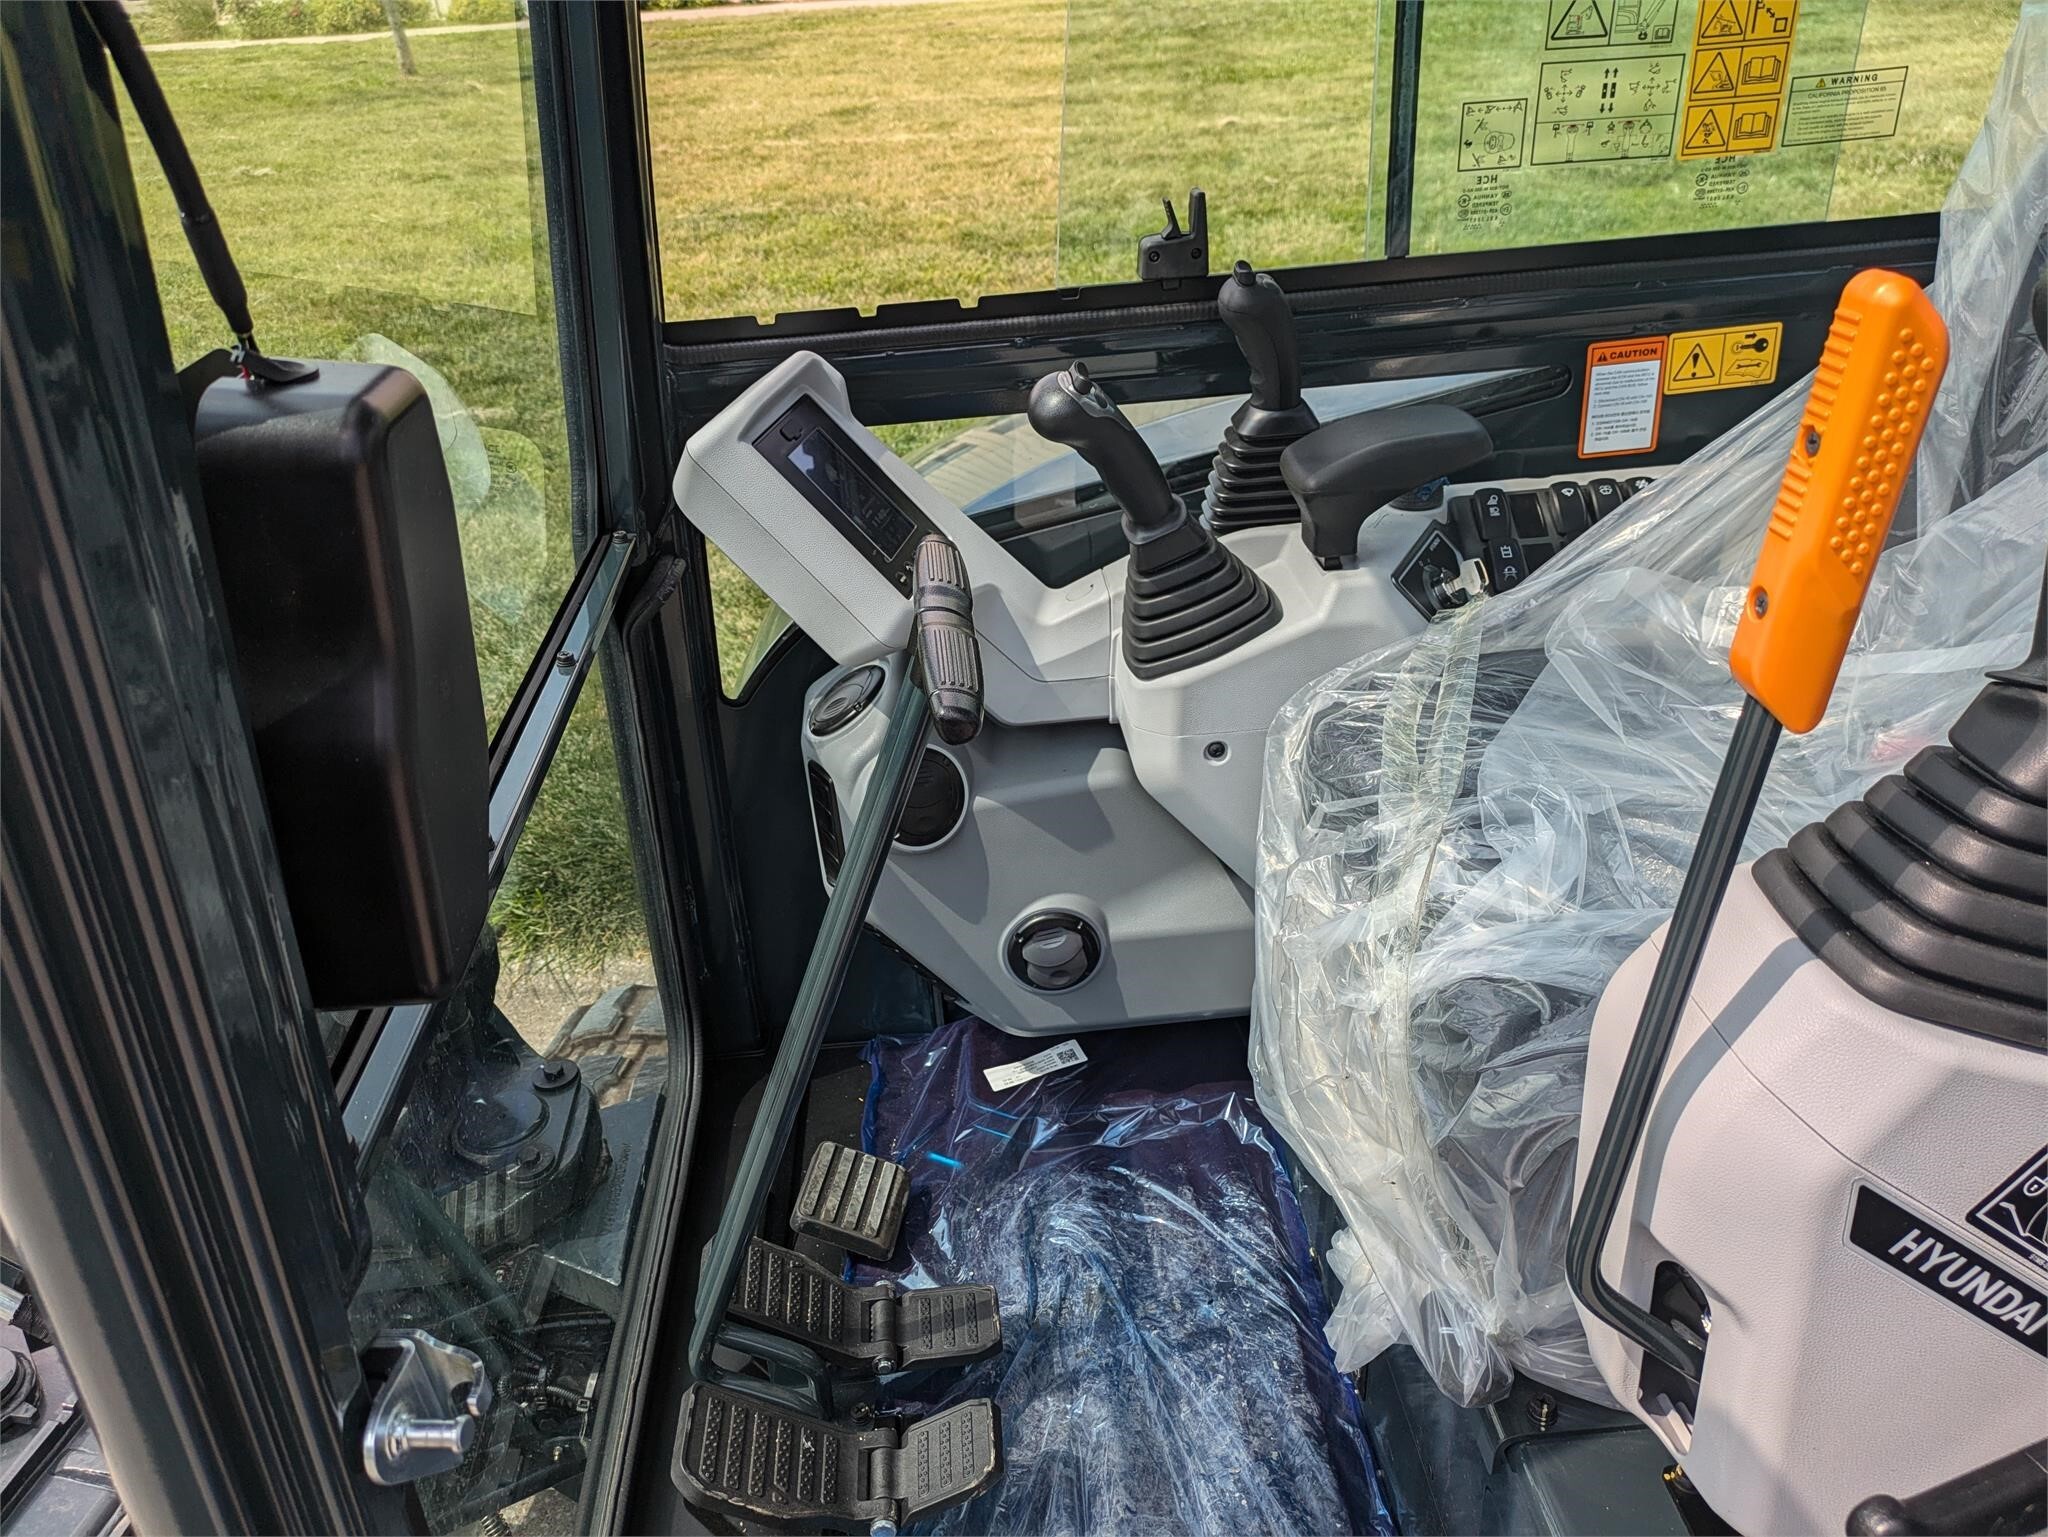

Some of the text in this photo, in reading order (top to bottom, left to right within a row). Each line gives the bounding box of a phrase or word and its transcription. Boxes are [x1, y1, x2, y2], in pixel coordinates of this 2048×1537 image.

[1831, 74, 1878, 85] WARNING
[1807, 90, 1841, 99] CALIFORNIA
[1841, 87, 1878, 96] PROPOSITION
[1609, 347, 1658, 360] CAUTION
